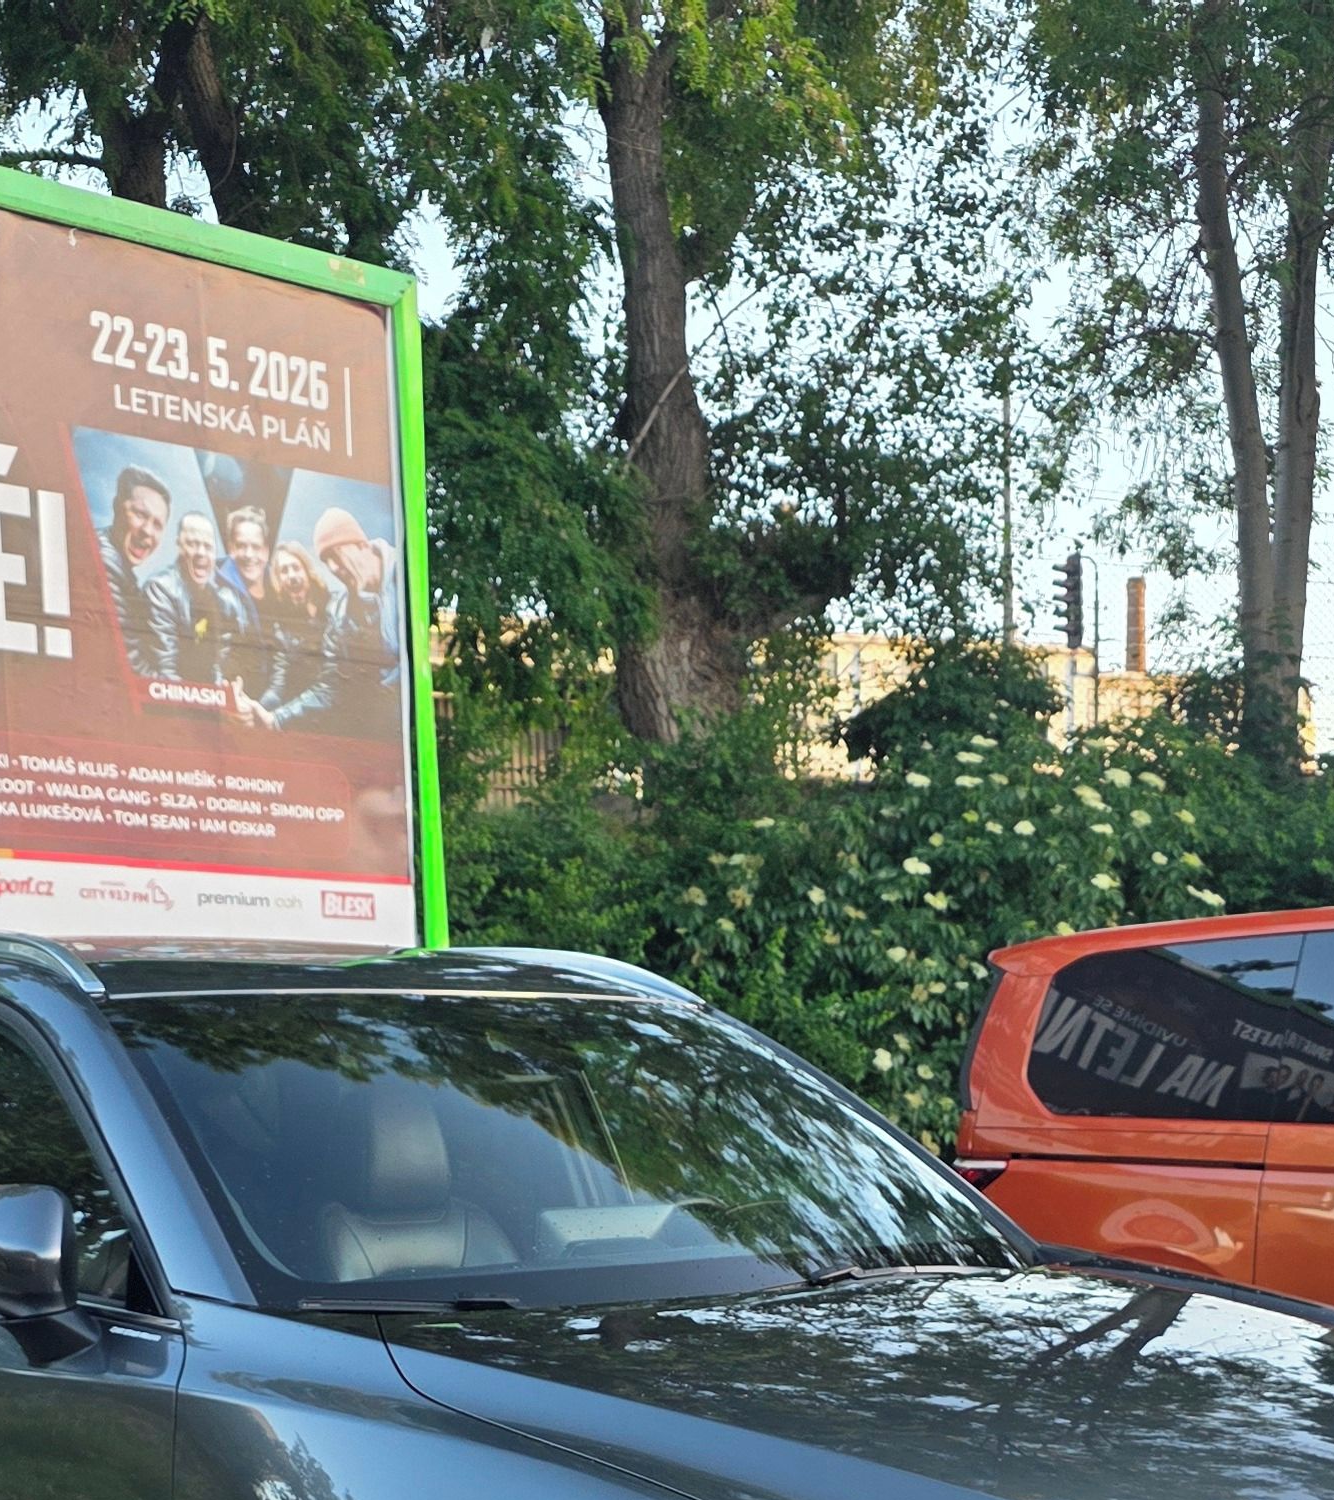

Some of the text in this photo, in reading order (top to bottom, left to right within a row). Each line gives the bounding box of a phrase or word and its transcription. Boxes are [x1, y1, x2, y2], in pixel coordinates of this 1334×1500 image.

[89, 309, 329, 411] 22-23. 5. 2026
[113, 383, 331, 453] LETENSKÁ PLÁŇ
[148, 681, 227, 707] CHINASKI
[18, 754, 76, 776] TOMÁŠ
[77, 760, 119, 779] KLUS
[127, 766, 174, 785] ADAM
[44, 781, 105, 802] WALDA
[106, 786, 151, 806] GANG
[160, 792, 198, 810] SLZA
[206, 795, 262, 815] DORIAN
[270, 802, 315, 820] SIMON
[316, 804, 345, 823] OPP
[20, 801, 105, 824] LUKEŠOVÁ
[113, 808, 149, 828] TOM
[150, 813, 190, 832] SEAN
[228, 820, 277, 838] OSKAR
[197, 892, 271, 908] premium
[324, 892, 373, 918] BLESK
